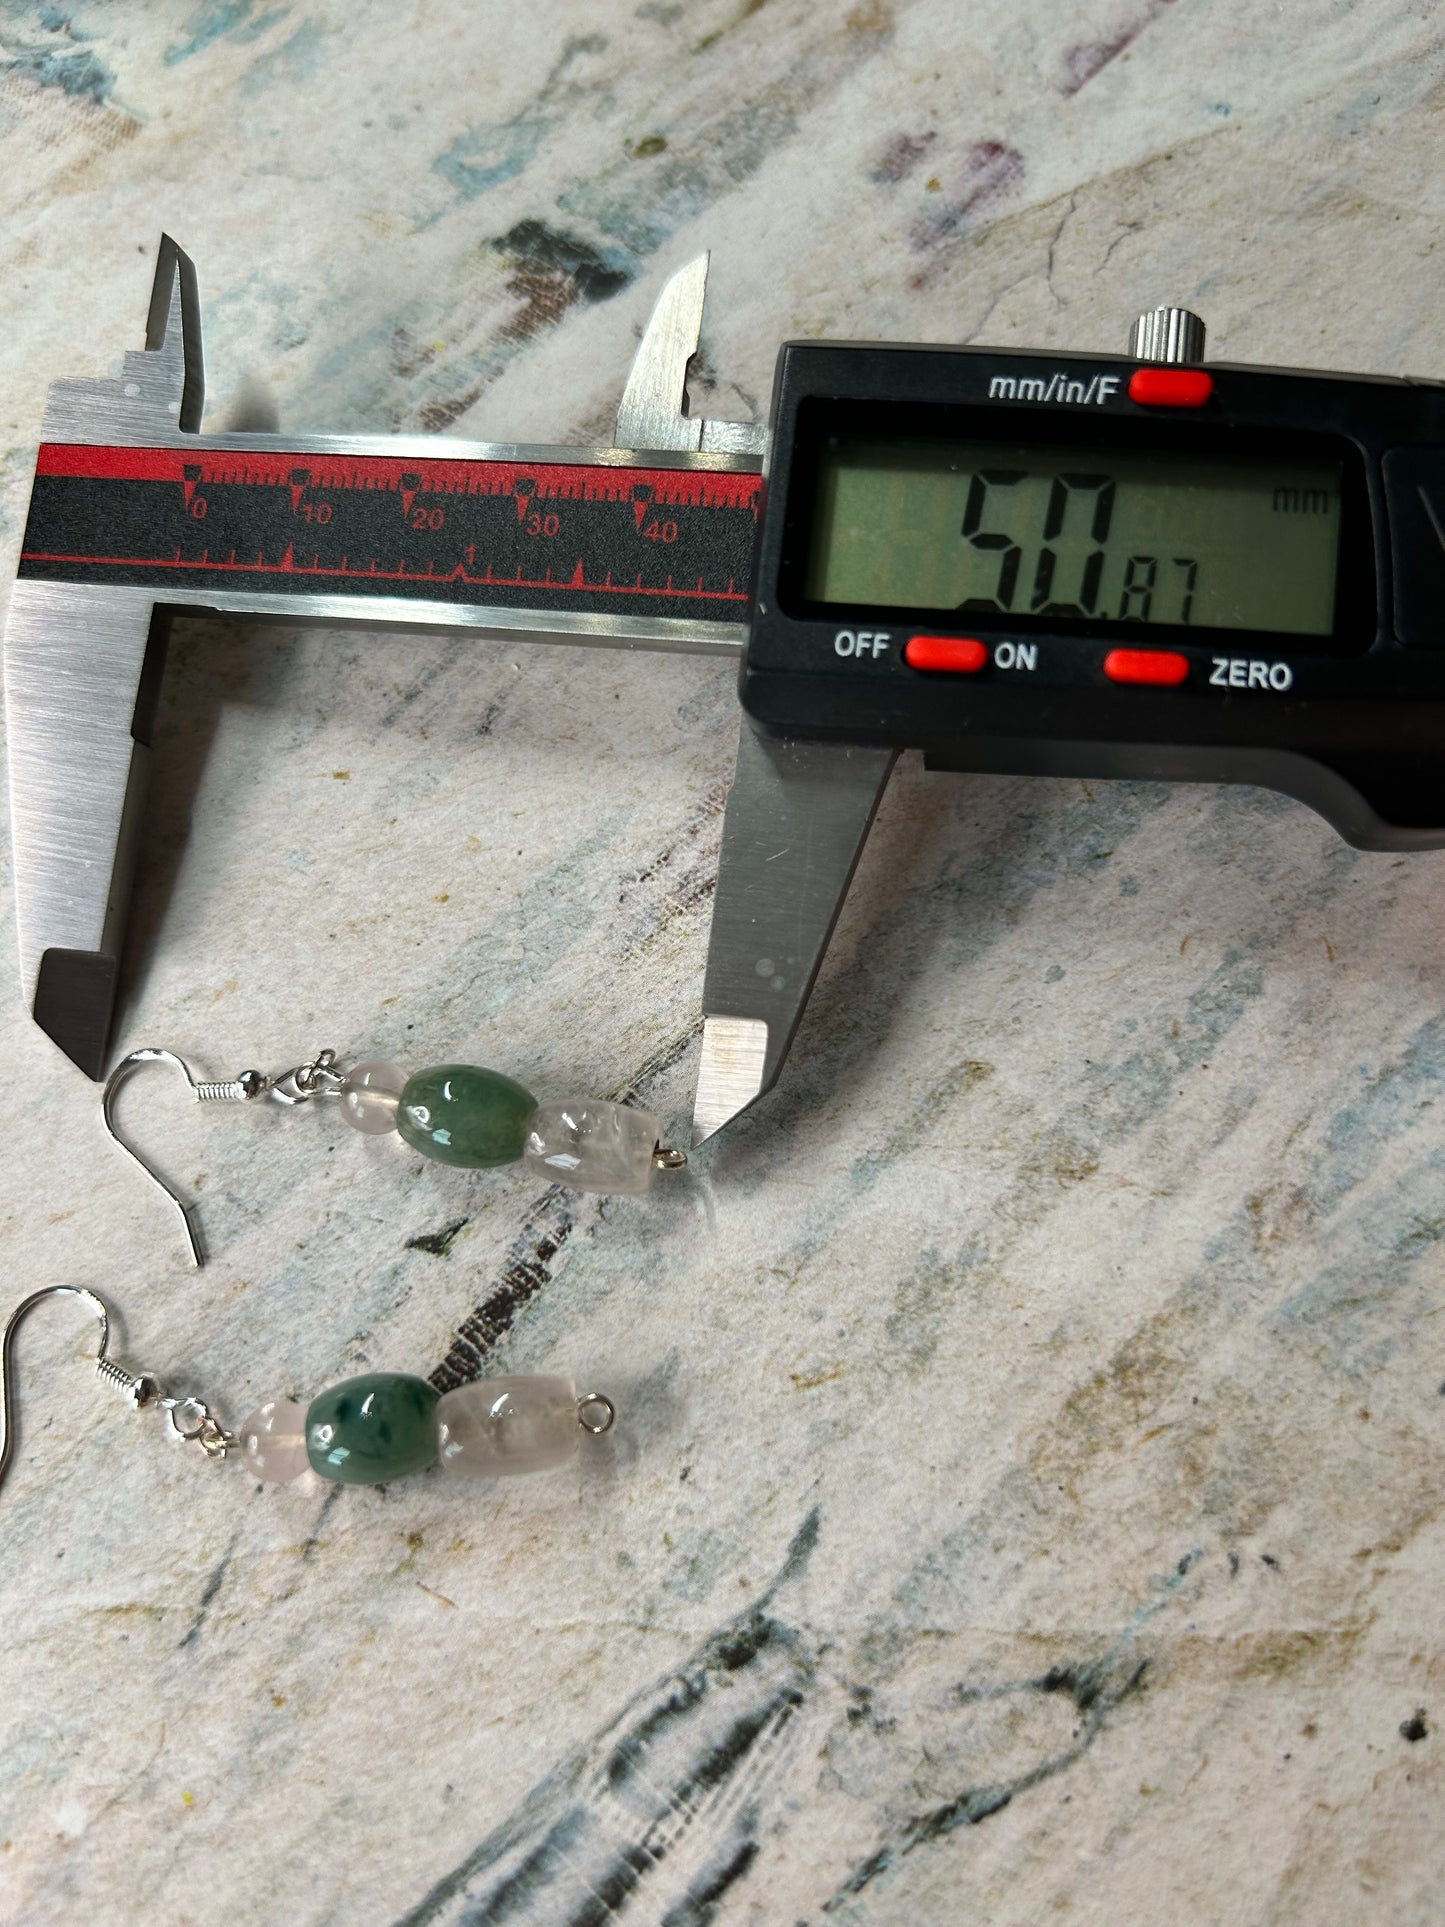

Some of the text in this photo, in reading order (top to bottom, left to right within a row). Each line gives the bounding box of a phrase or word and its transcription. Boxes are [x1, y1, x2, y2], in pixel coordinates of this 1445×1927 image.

[988, 373, 1121, 405] mm/in/F
[1272, 485, 1330, 514] mm
[191, 497, 679, 544] 0 10 20 30 40
[833, 630, 891, 660] OFF
[994, 642, 1038, 672] ON
[1208, 658, 1294, 692] ZERO
